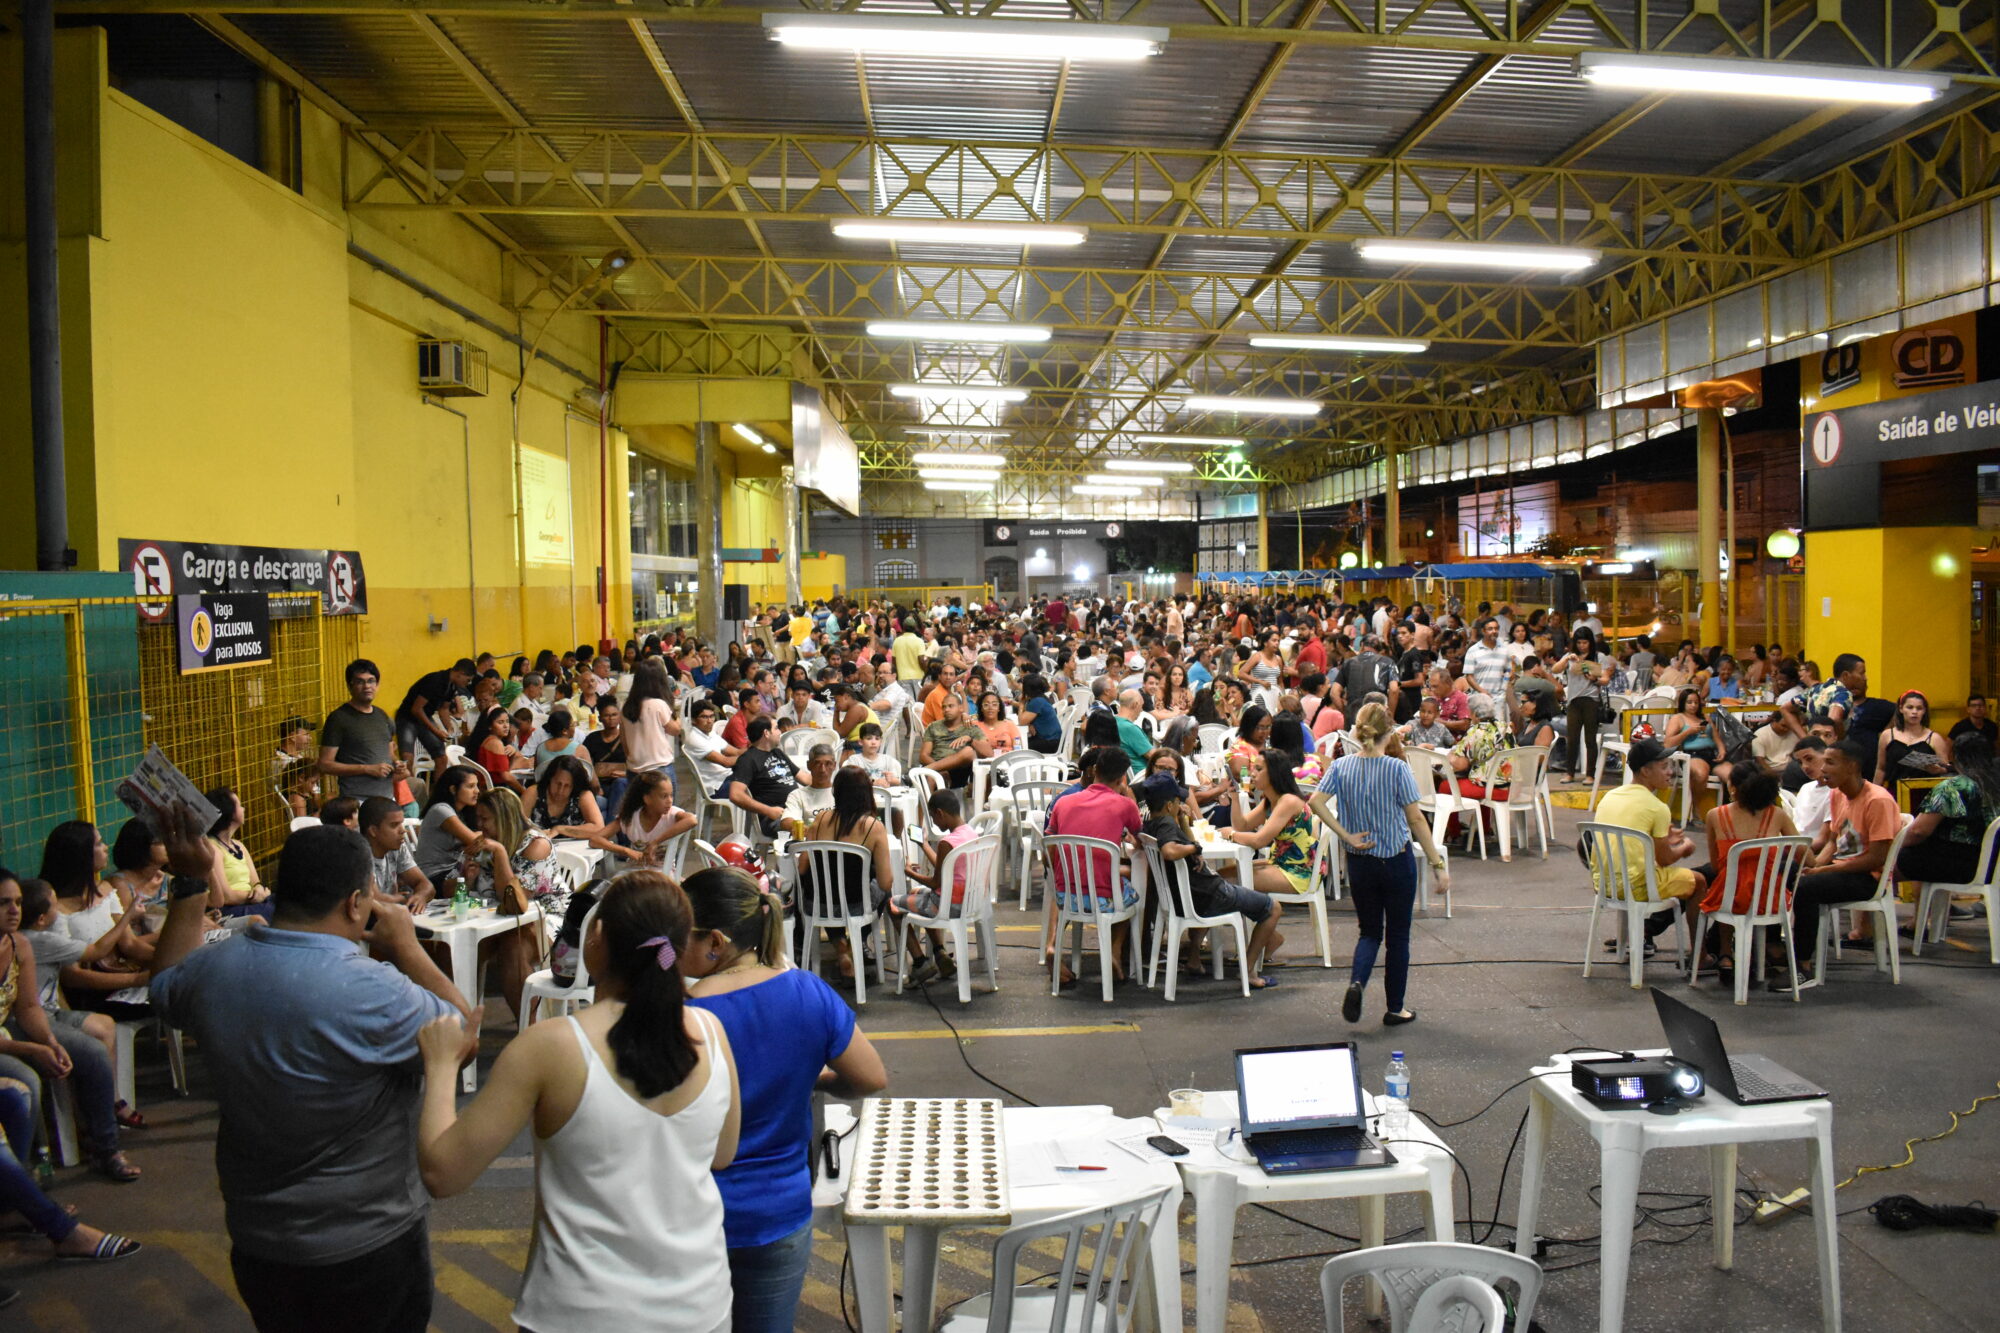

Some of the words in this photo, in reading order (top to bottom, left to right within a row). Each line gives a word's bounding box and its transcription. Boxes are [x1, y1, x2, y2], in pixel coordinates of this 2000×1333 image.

[1891, 329, 1964, 377] CD
[1879, 415, 1928, 441] Saída
[1934, 411, 1958, 433] de
[182, 551, 238, 585] Carga
[240, 561, 250, 580] e
[253, 555, 323, 586] descarga
[213, 602, 233, 620] Vaga
[214, 621, 254, 638] EXCLUSIVA
[215, 646, 233, 663] para
[234, 641, 262, 657] IDOSOS
